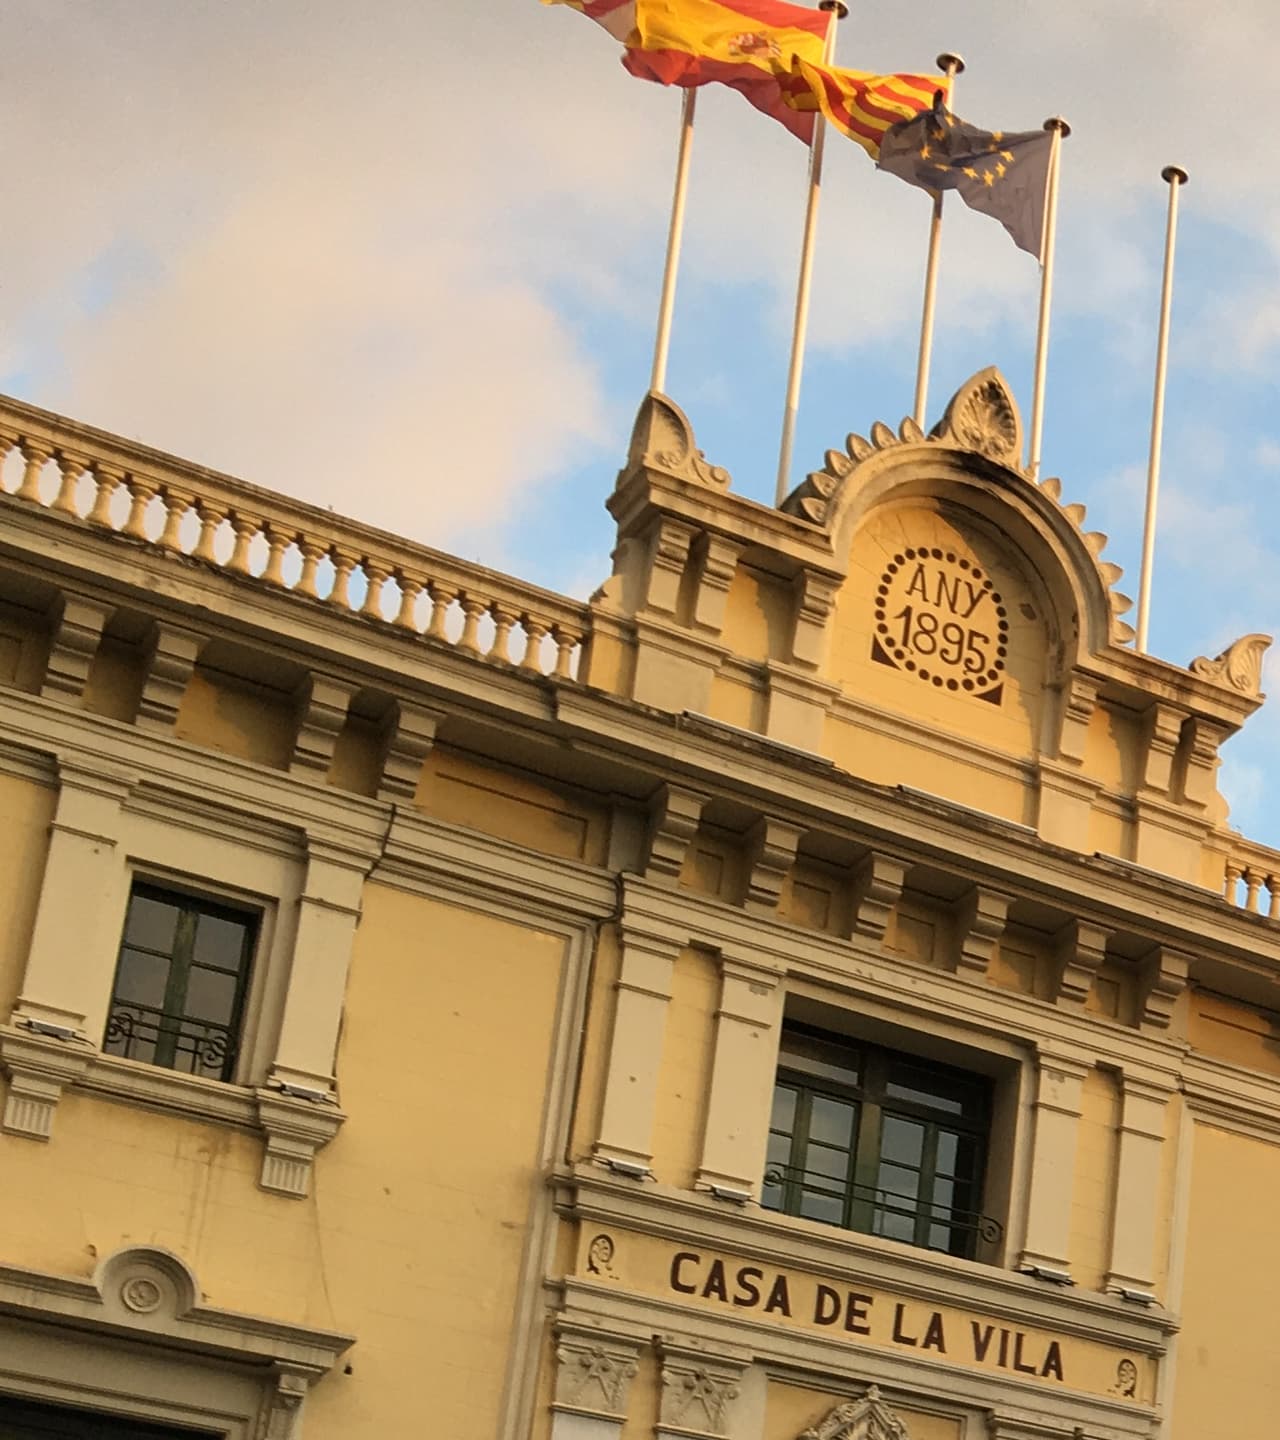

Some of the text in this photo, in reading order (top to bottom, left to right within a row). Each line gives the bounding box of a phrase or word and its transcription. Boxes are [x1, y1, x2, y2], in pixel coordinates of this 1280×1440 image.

[904, 562, 989, 619] ANY
[893, 605, 990, 675] 1895
[669, 1251, 1064, 1382] CASA DE LA VILA
